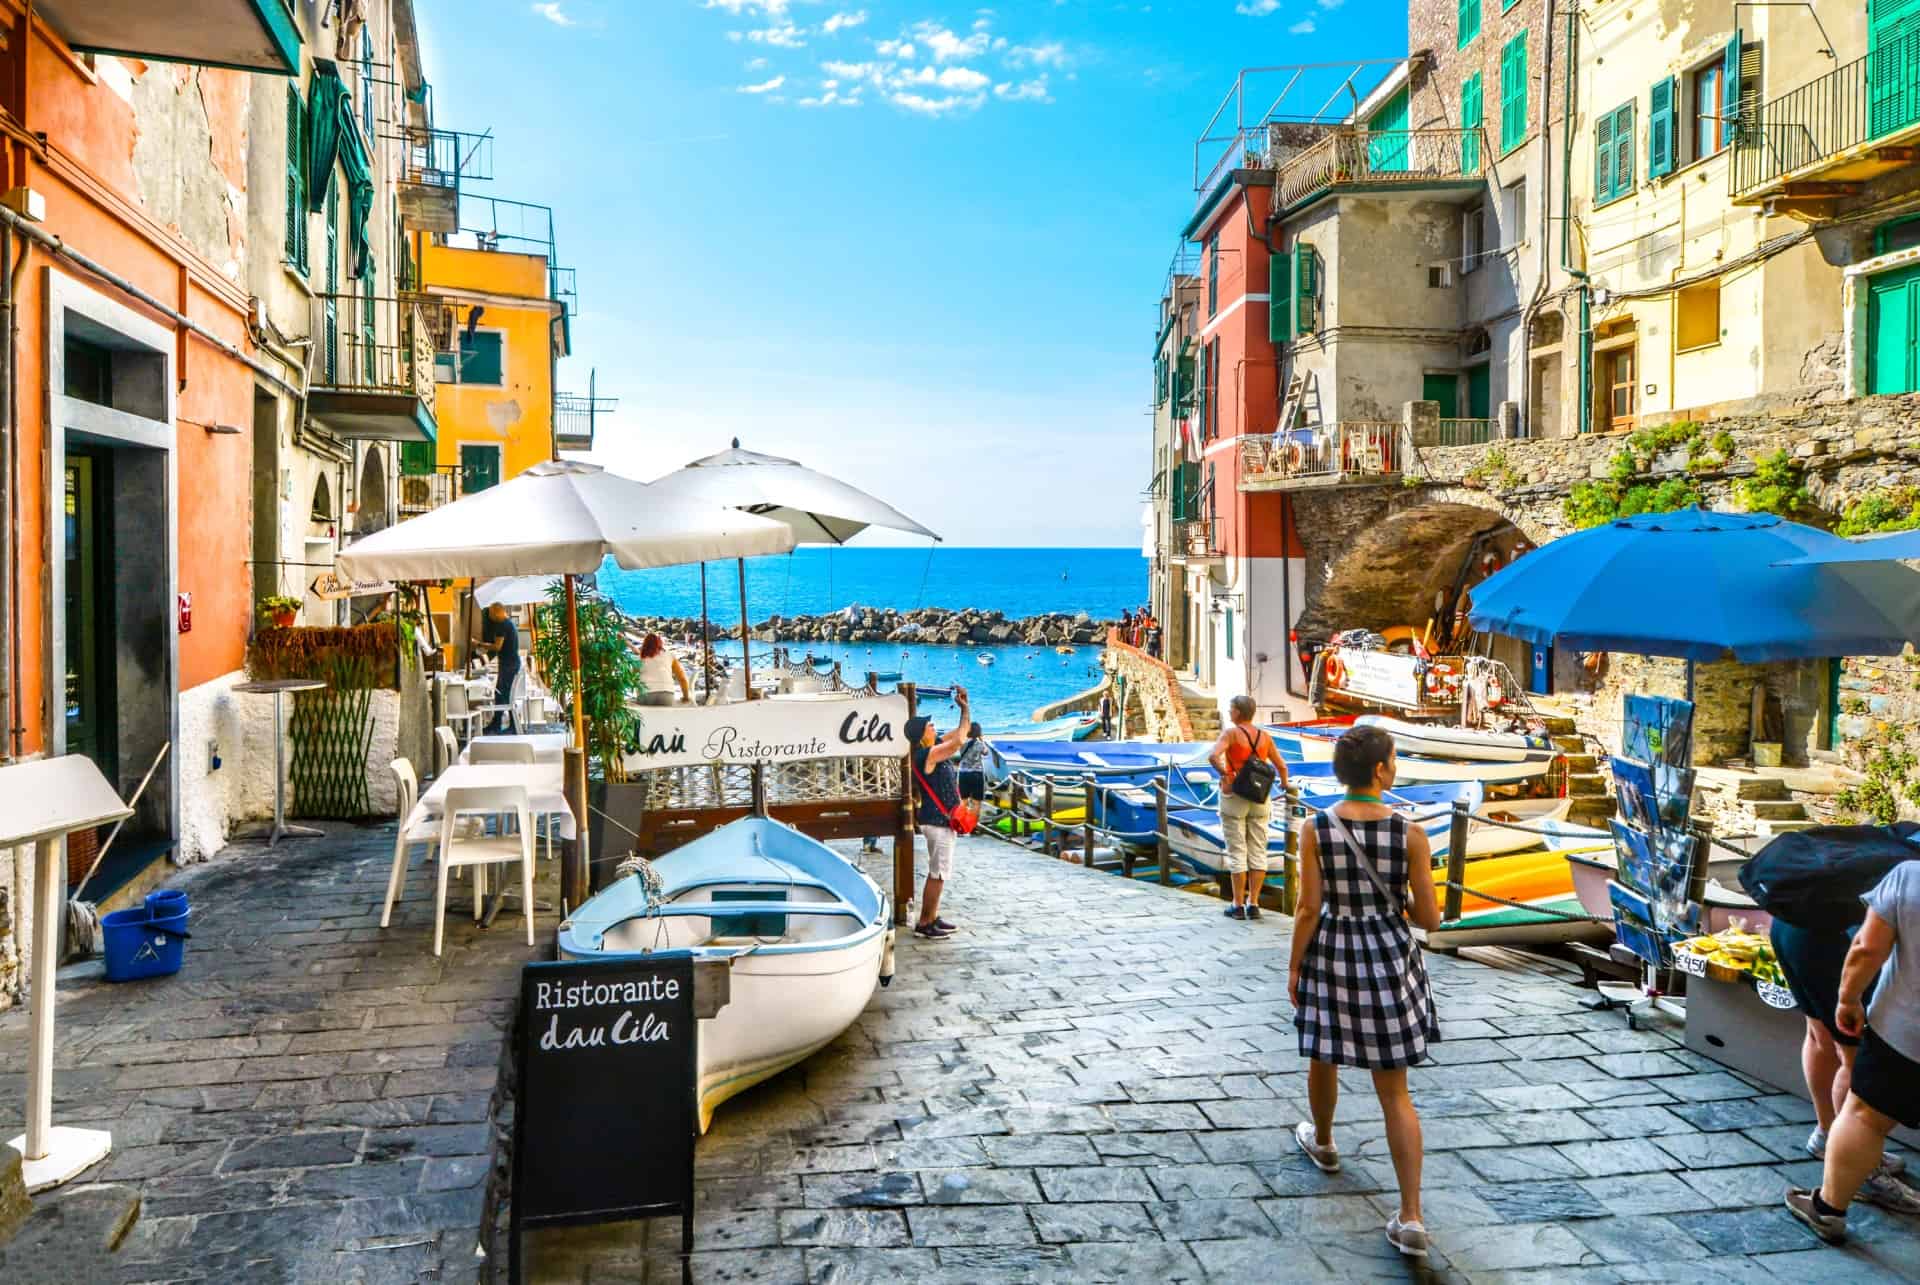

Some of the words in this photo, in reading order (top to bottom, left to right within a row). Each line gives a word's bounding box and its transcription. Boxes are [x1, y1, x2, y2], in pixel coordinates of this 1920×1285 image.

[703, 726, 827, 759] Ristorante
[839, 710, 893, 743] Cila
[536, 975, 679, 1009] Ristorante
[611, 1010, 670, 1044] Cila
